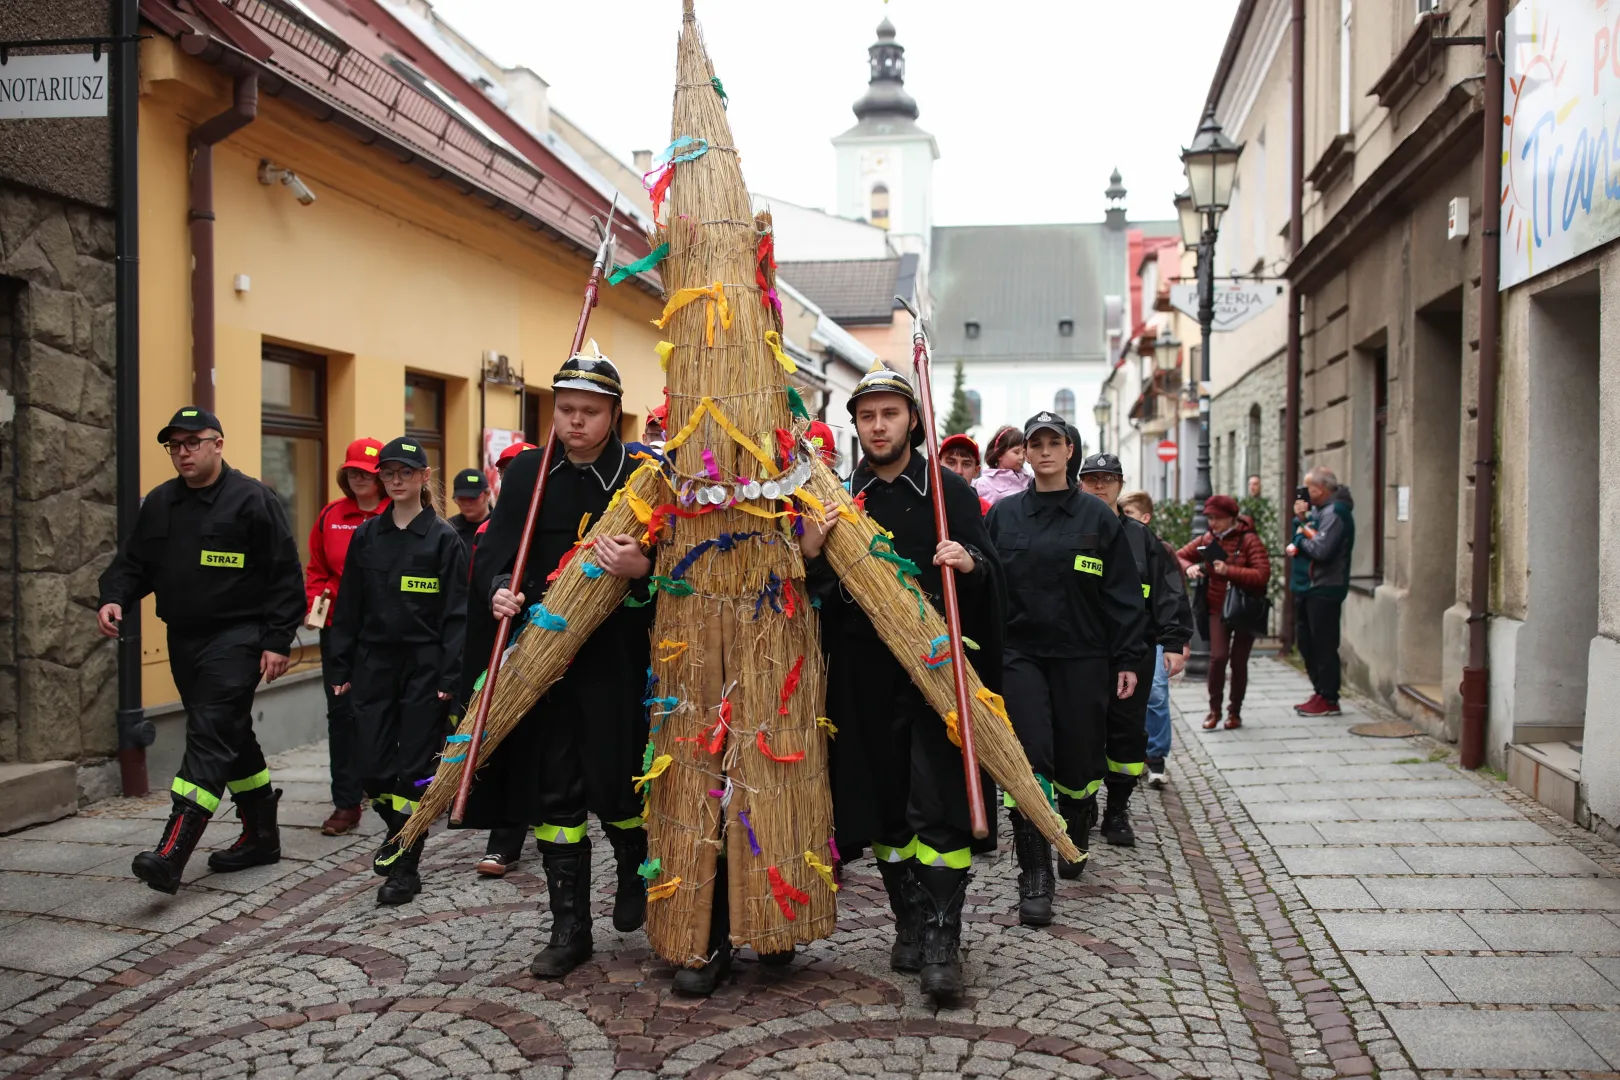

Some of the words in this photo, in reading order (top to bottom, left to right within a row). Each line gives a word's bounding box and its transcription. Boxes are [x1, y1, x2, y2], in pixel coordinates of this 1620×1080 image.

[0, 75, 104, 102] NOTARIUSZ
[1188, 292, 1263, 305] PZERIA
[206, 554, 238, 564] STRAZ
[407, 580, 437, 589] STRAZ
